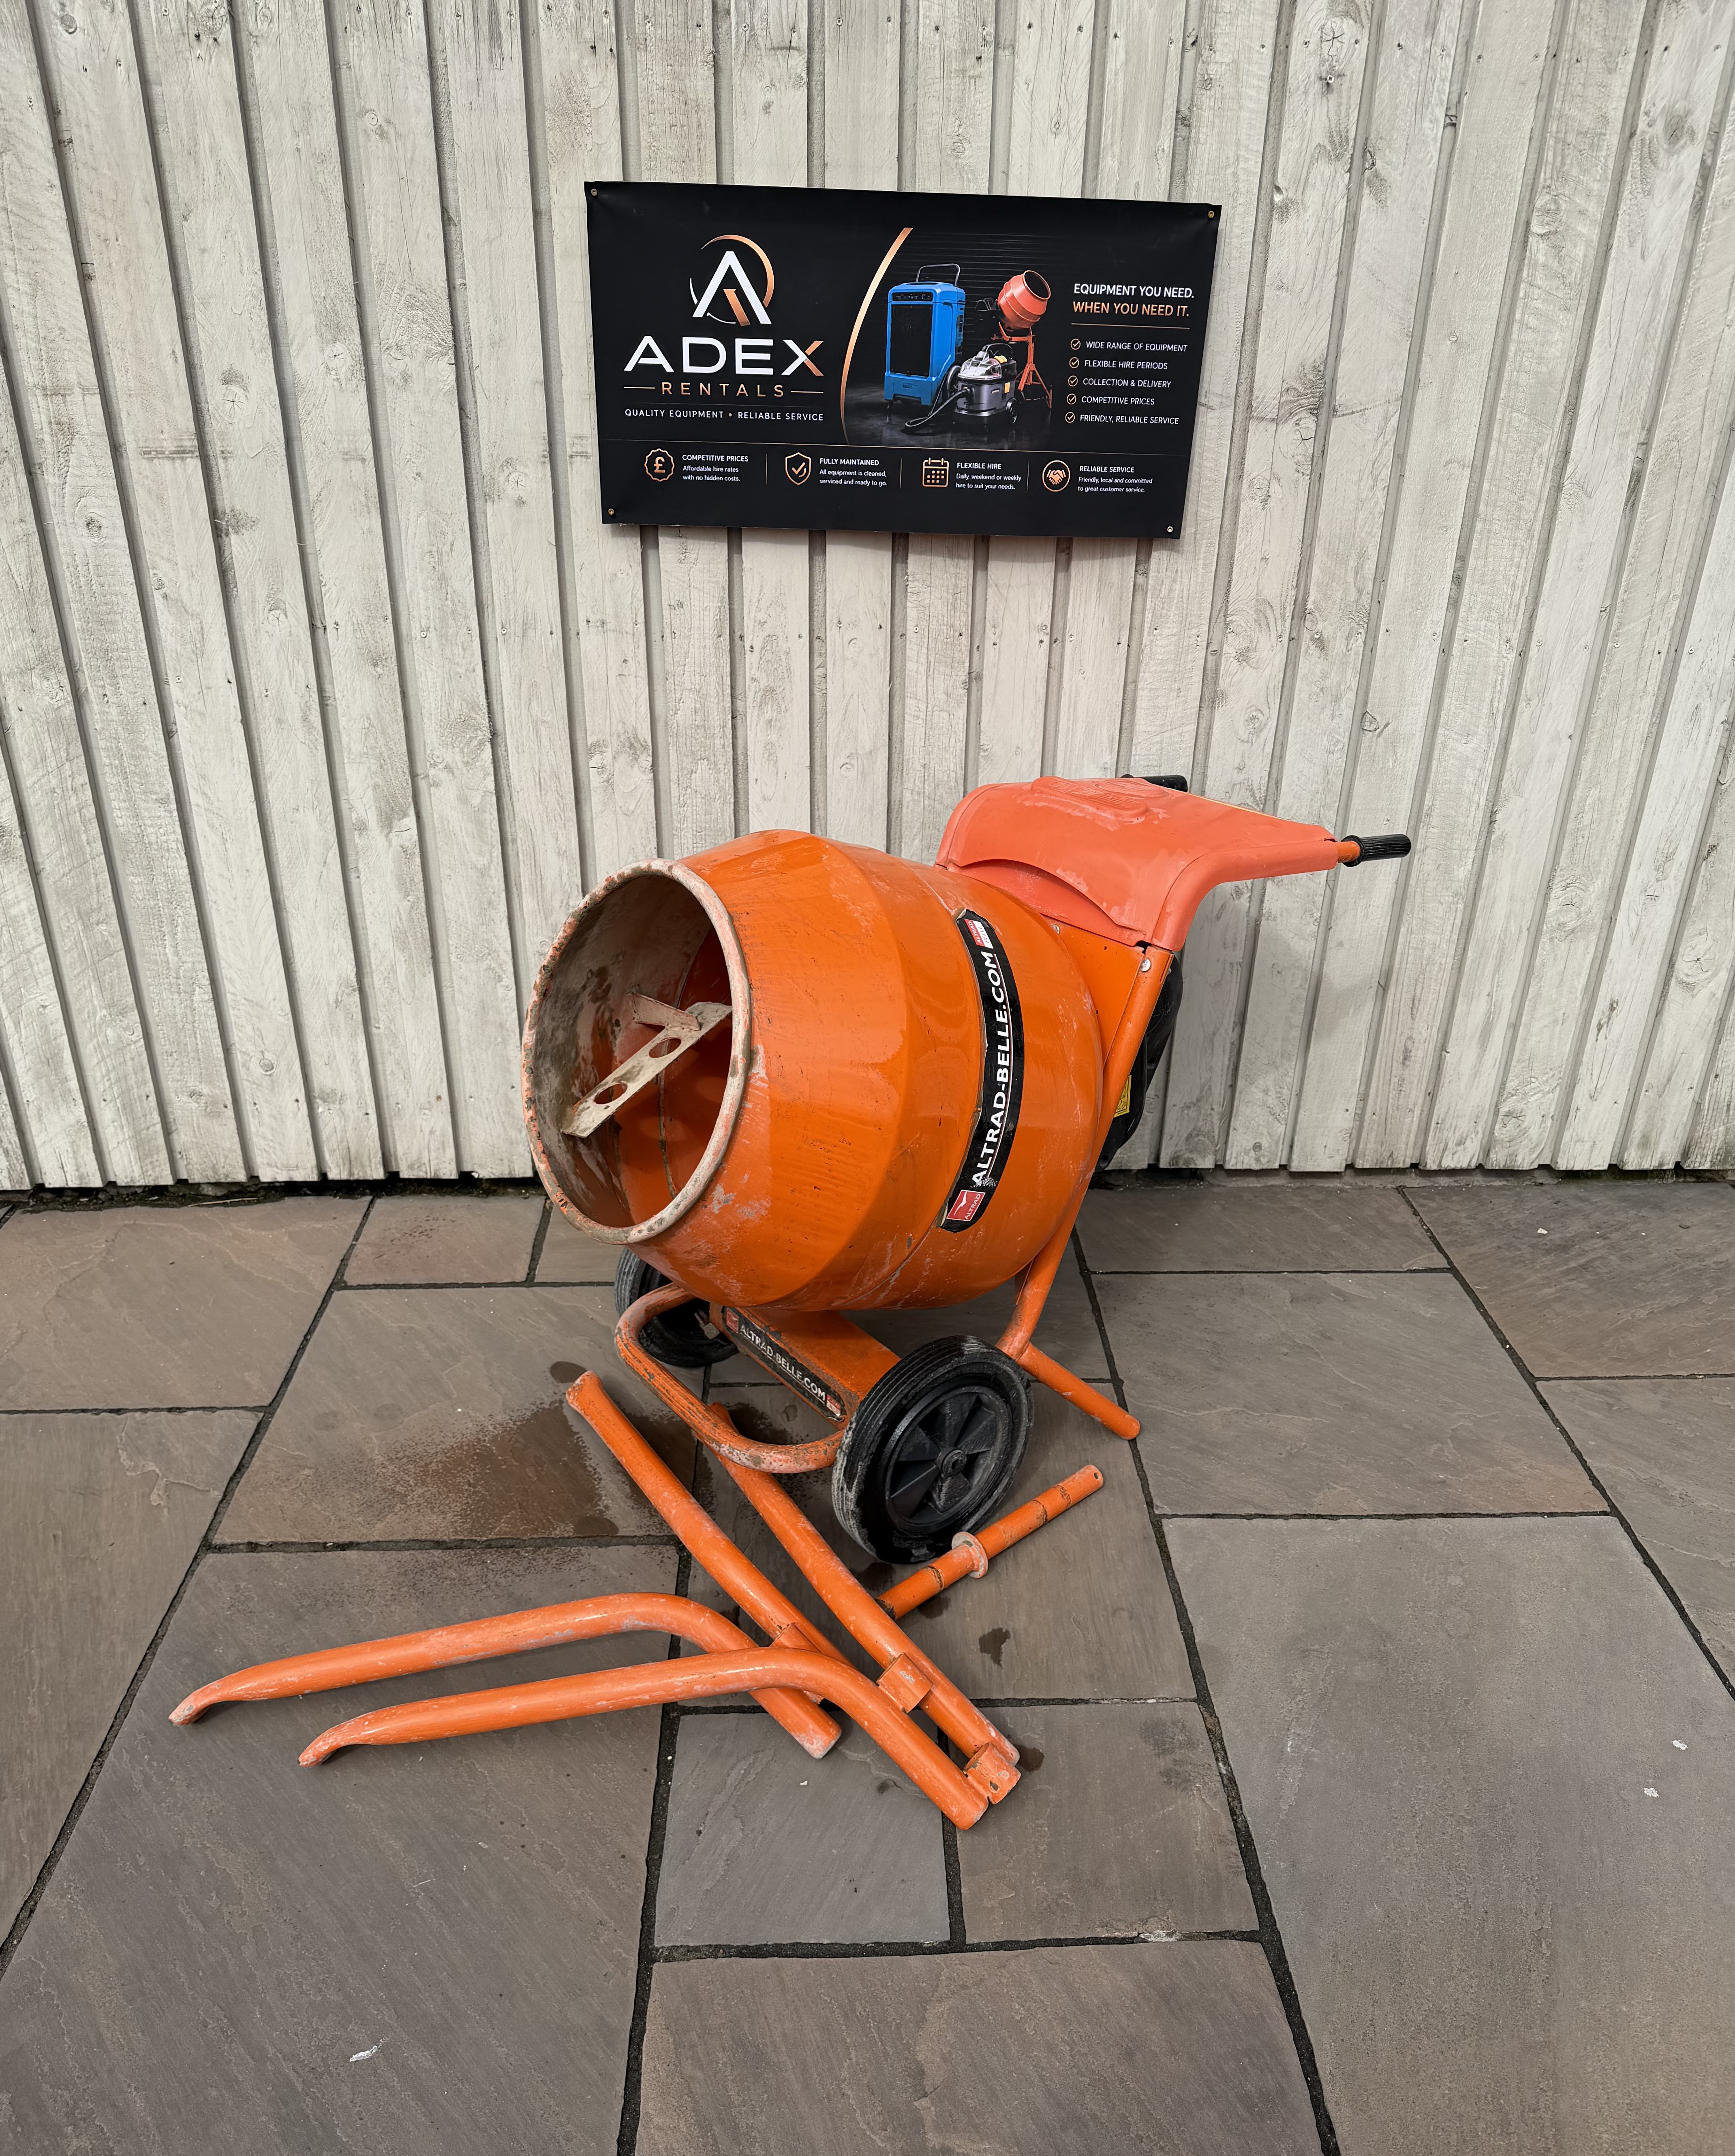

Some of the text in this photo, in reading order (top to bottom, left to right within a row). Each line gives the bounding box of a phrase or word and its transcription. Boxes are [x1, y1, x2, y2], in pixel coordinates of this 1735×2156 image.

[1074, 284, 1194, 298] EQUIPMENT YOU NEED.
[1073, 301, 1189, 316] WHEN YOU NEED IT.
[624, 336, 824, 376] ADEX
[662, 382, 783, 397] RENTALS
[1083, 378, 1128, 386] COLLECTION
[1080, 415, 1113, 423] FRIENDLY,
[967, 921, 982, 944] ALTRAD
[972, 952, 1009, 1184] ALTRAD-BELLE.COM
[965, 1193, 981, 1220] ALTRAD
